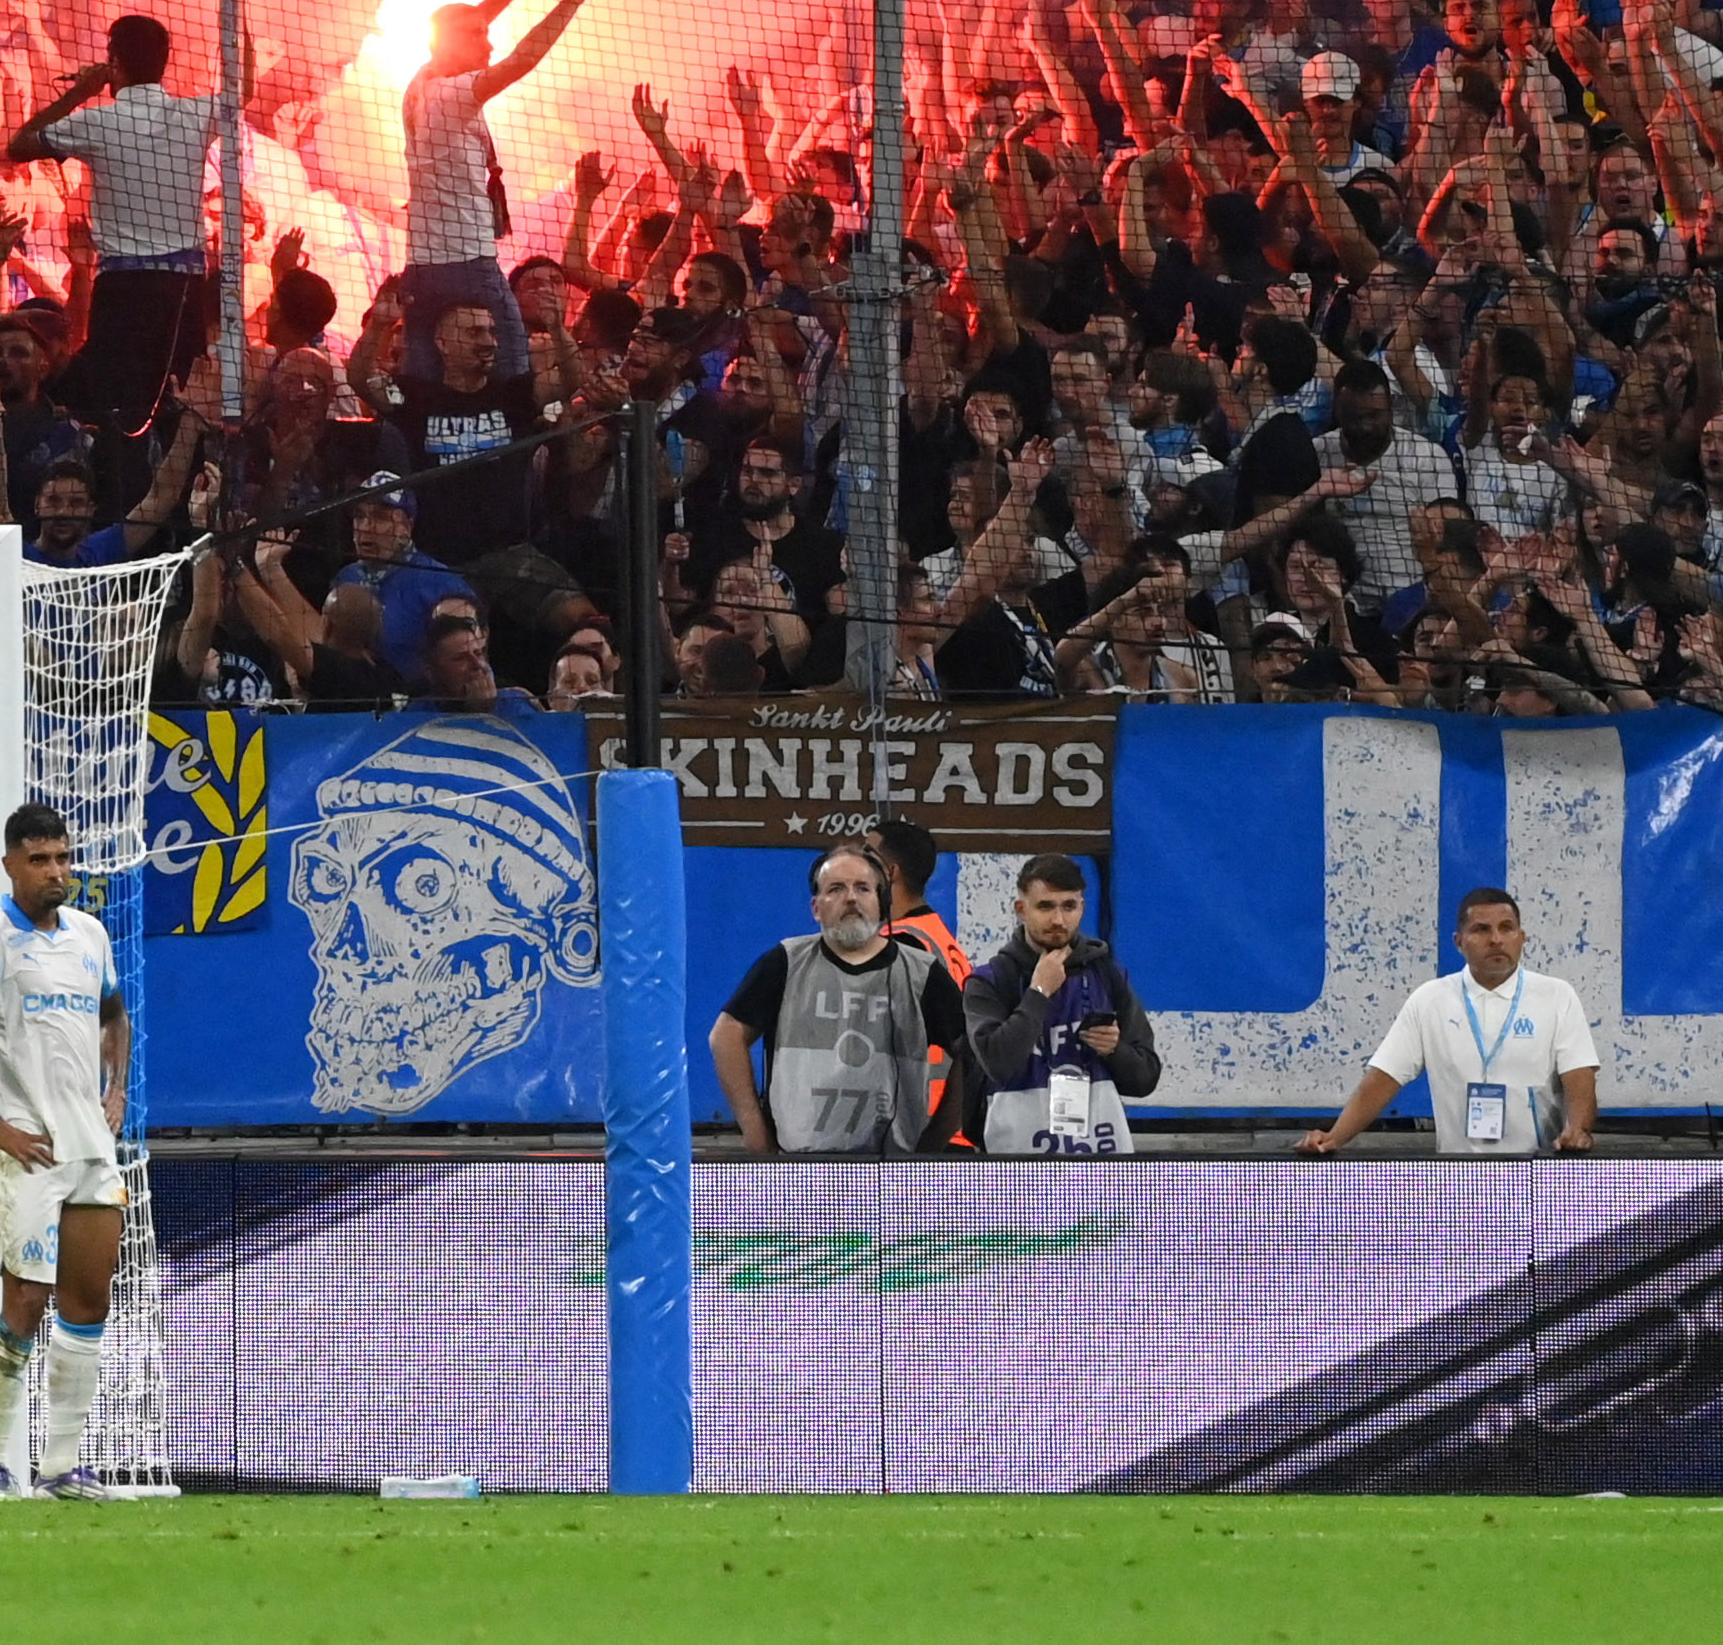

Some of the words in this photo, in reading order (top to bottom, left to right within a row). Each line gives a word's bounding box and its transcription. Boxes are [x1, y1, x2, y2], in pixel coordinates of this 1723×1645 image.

[426, 409, 507, 437] ULTRAS
[748, 703, 844, 733] Sankt
[849, 705, 953, 734] Pauli
[815, 813, 883, 837] 1996
[22, 993, 68, 1014] CMA
[811, 1087, 870, 1134] 77
